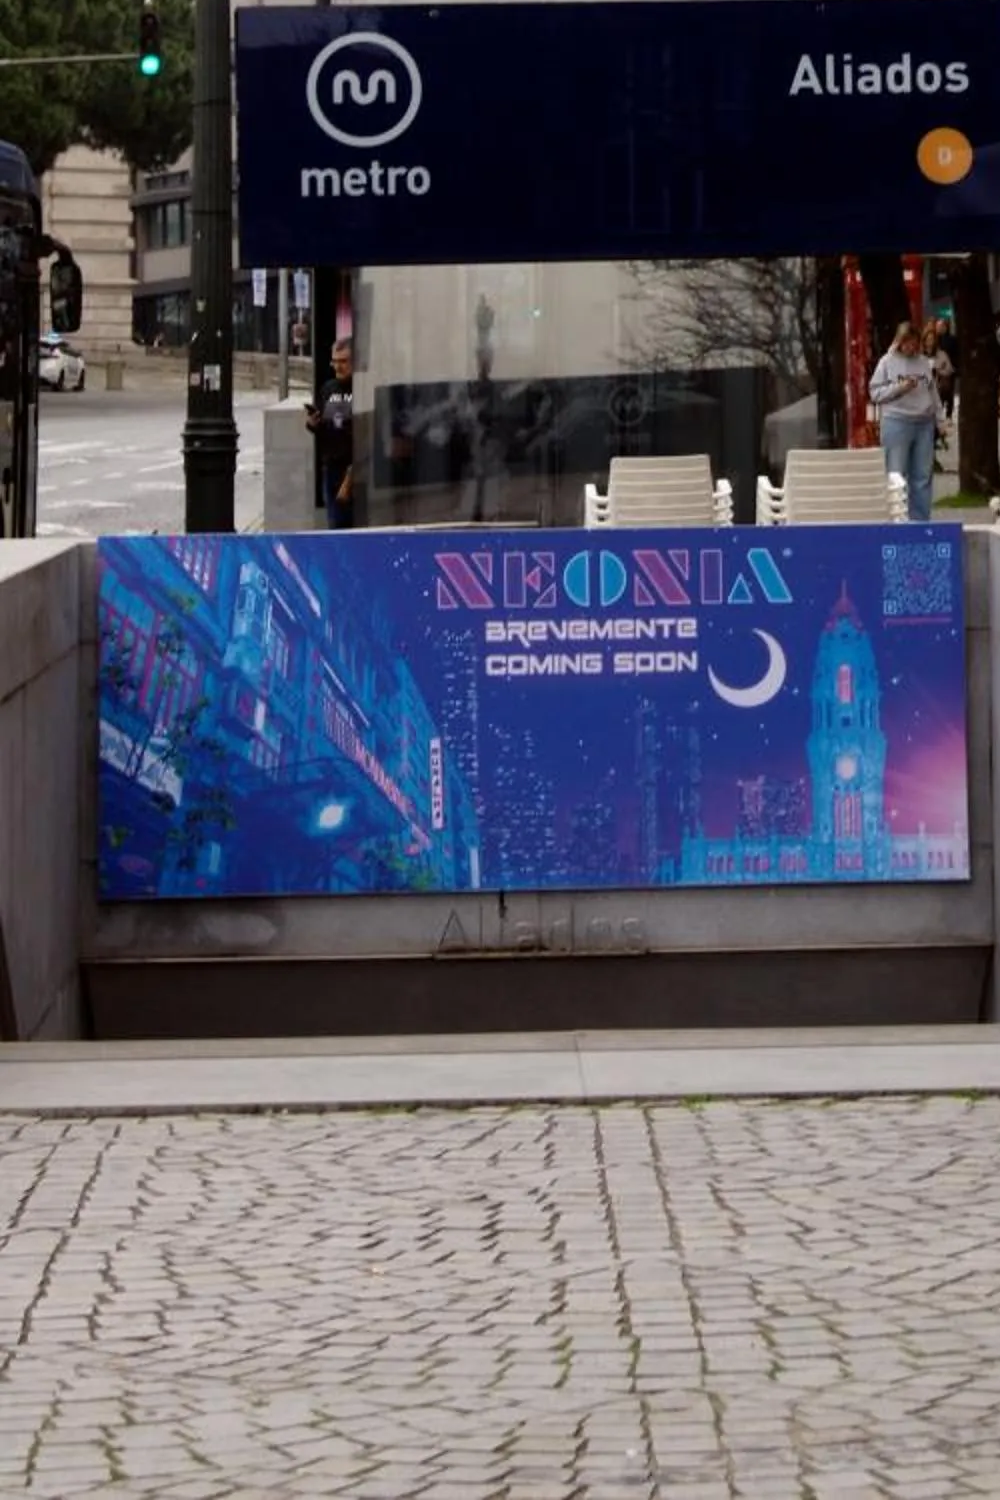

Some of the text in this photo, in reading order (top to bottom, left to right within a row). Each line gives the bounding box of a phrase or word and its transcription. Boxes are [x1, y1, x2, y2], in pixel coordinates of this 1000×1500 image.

[789, 52, 970, 96] Aliados
[937, 146, 952, 166] D
[300, 160, 431, 197] metro
[434, 547, 793, 610] NEONIA
[485, 651, 698, 676] COMING SOON
